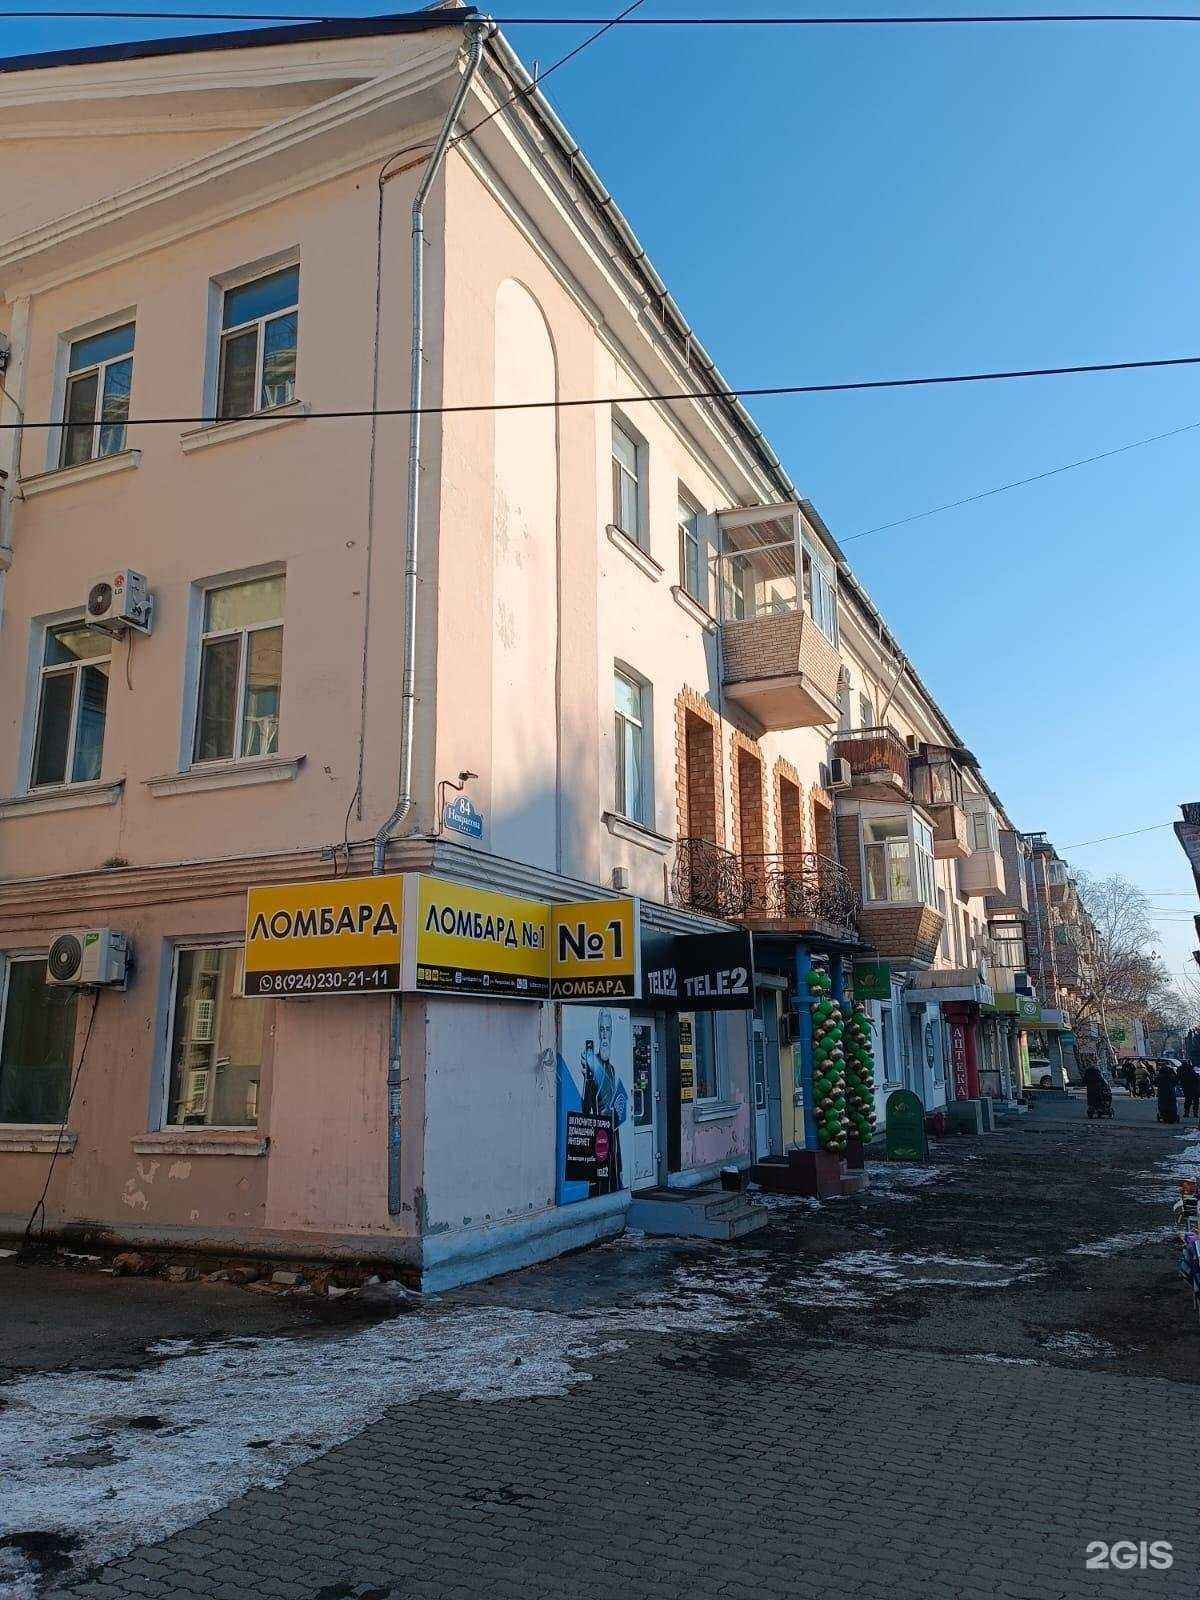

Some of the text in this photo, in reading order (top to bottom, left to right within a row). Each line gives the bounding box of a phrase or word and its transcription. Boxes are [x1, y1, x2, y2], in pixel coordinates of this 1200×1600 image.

[459, 798, 471, 815] 84
[250, 903, 399, 940] ЛОМБАРД
[425, 903, 546, 949] ЛОМБАРД №1
[557, 920, 623, 963] №1
[274, 969, 389, 991] 8(924)230-21-11
[552, 980, 626, 996] ЛОМБАРД
[647, 967, 678, 997] TELE2
[683, 966, 749, 997] TELE2
[953, 1027, 968, 1096] АПТЕКА
